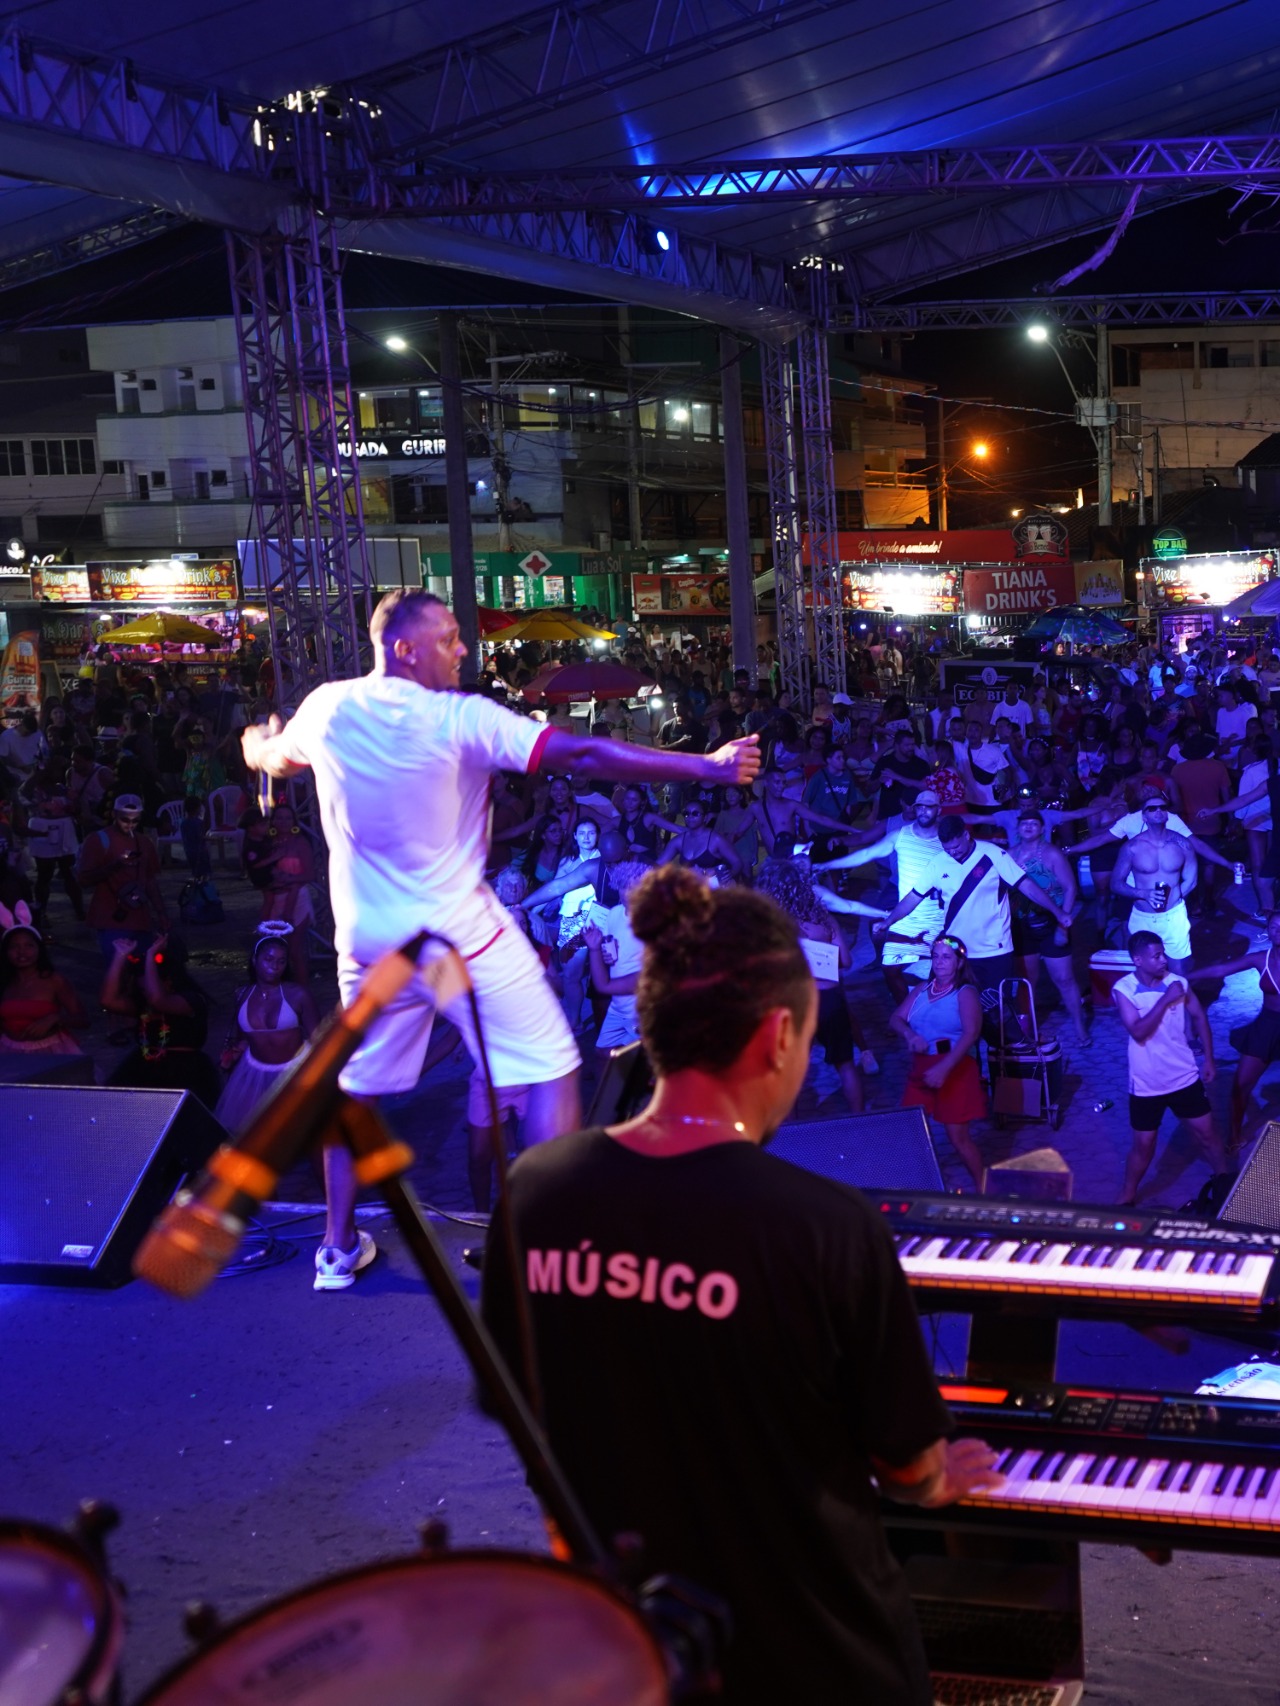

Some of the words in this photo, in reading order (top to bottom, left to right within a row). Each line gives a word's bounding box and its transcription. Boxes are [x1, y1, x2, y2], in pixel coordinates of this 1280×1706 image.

[1152, 539, 1169, 549] TOP
[1171, 539, 1187, 549] BAR
[582, 558, 599, 574] Lua
[607, 554, 622, 573] Sol
[992, 570, 1047, 589] TIANA
[986, 588, 1056, 610] DRINK'S
[1158, 1219, 1209, 1232] Roland
[527, 1239, 739, 1320] MÚSICO
[1209, 1366, 1263, 1397] scensão
